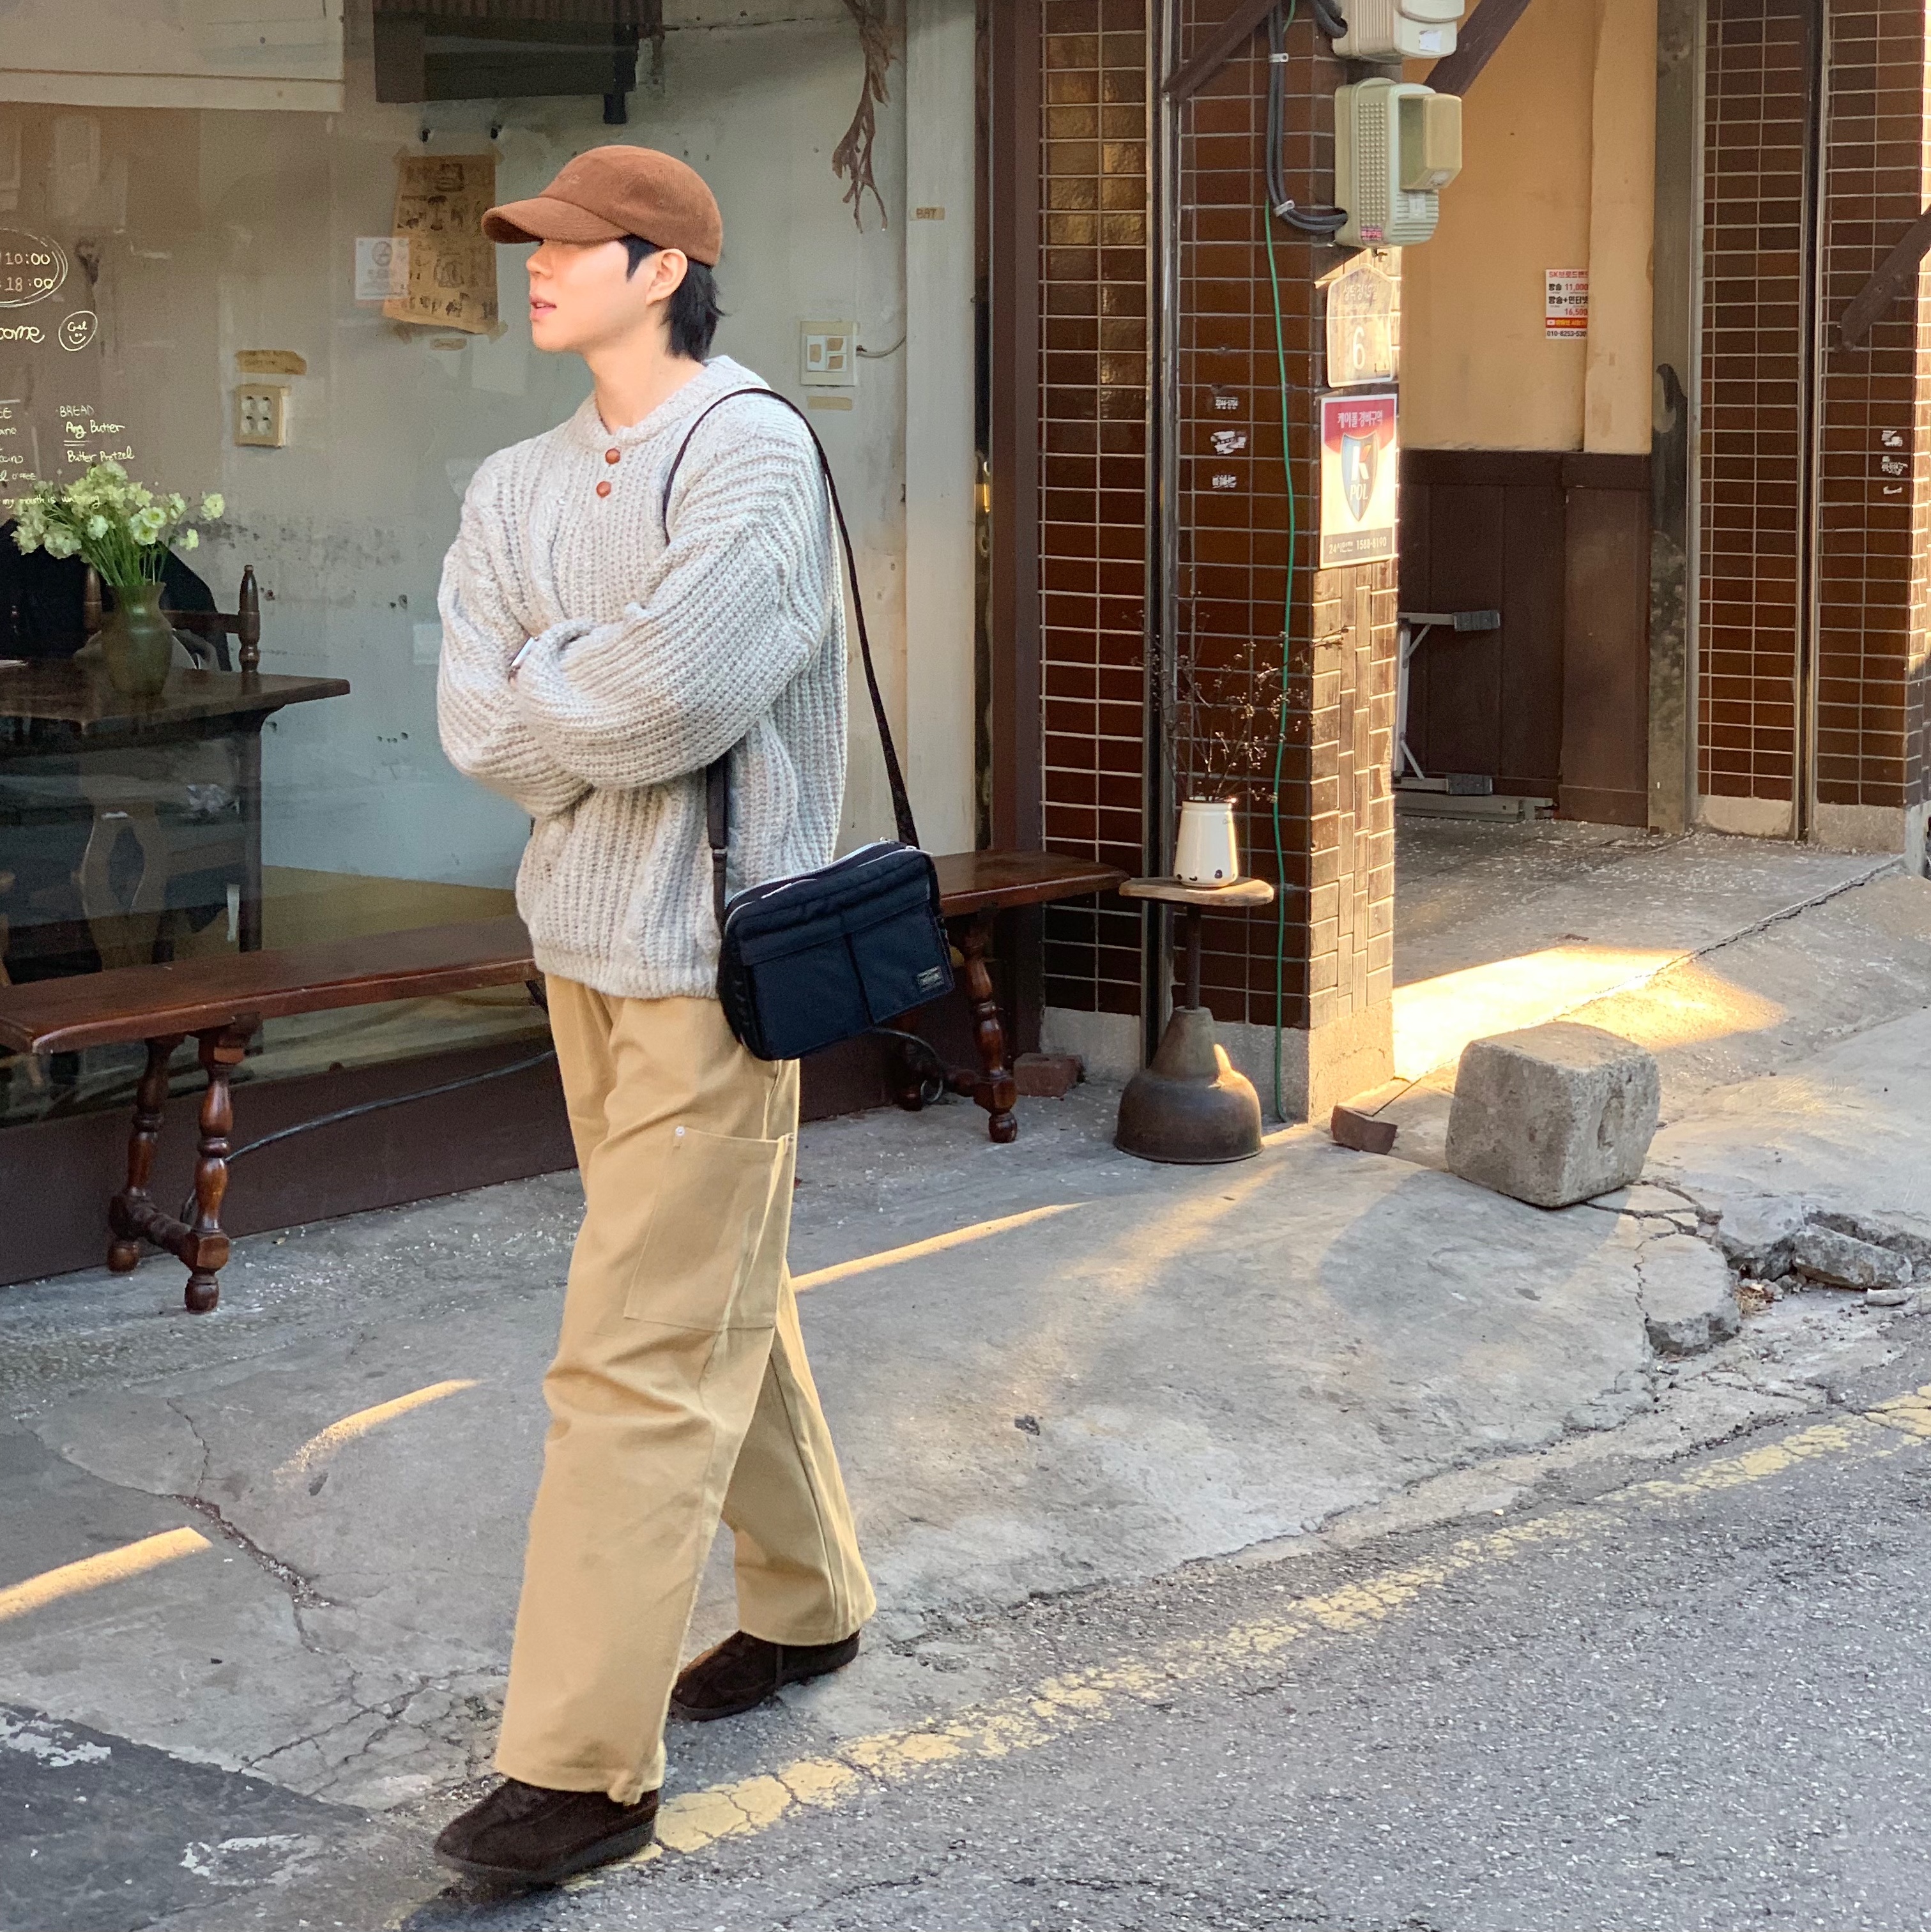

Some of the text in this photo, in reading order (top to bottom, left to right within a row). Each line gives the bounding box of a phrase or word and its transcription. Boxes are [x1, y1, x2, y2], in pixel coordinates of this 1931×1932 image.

[5, 252, 50, 266] 10:00
[4, 277, 54, 292] 18:00
[1352, 326, 1366, 370] 6
[60, 405, 95, 418] BREAD
[1338, 410, 1383, 429] 케이폴 경비구역
[89, 419, 125, 434] Butter
[100, 445, 135, 462] Pretzel
[1351, 445, 1371, 481] K
[1349, 483, 1369, 501] POL
